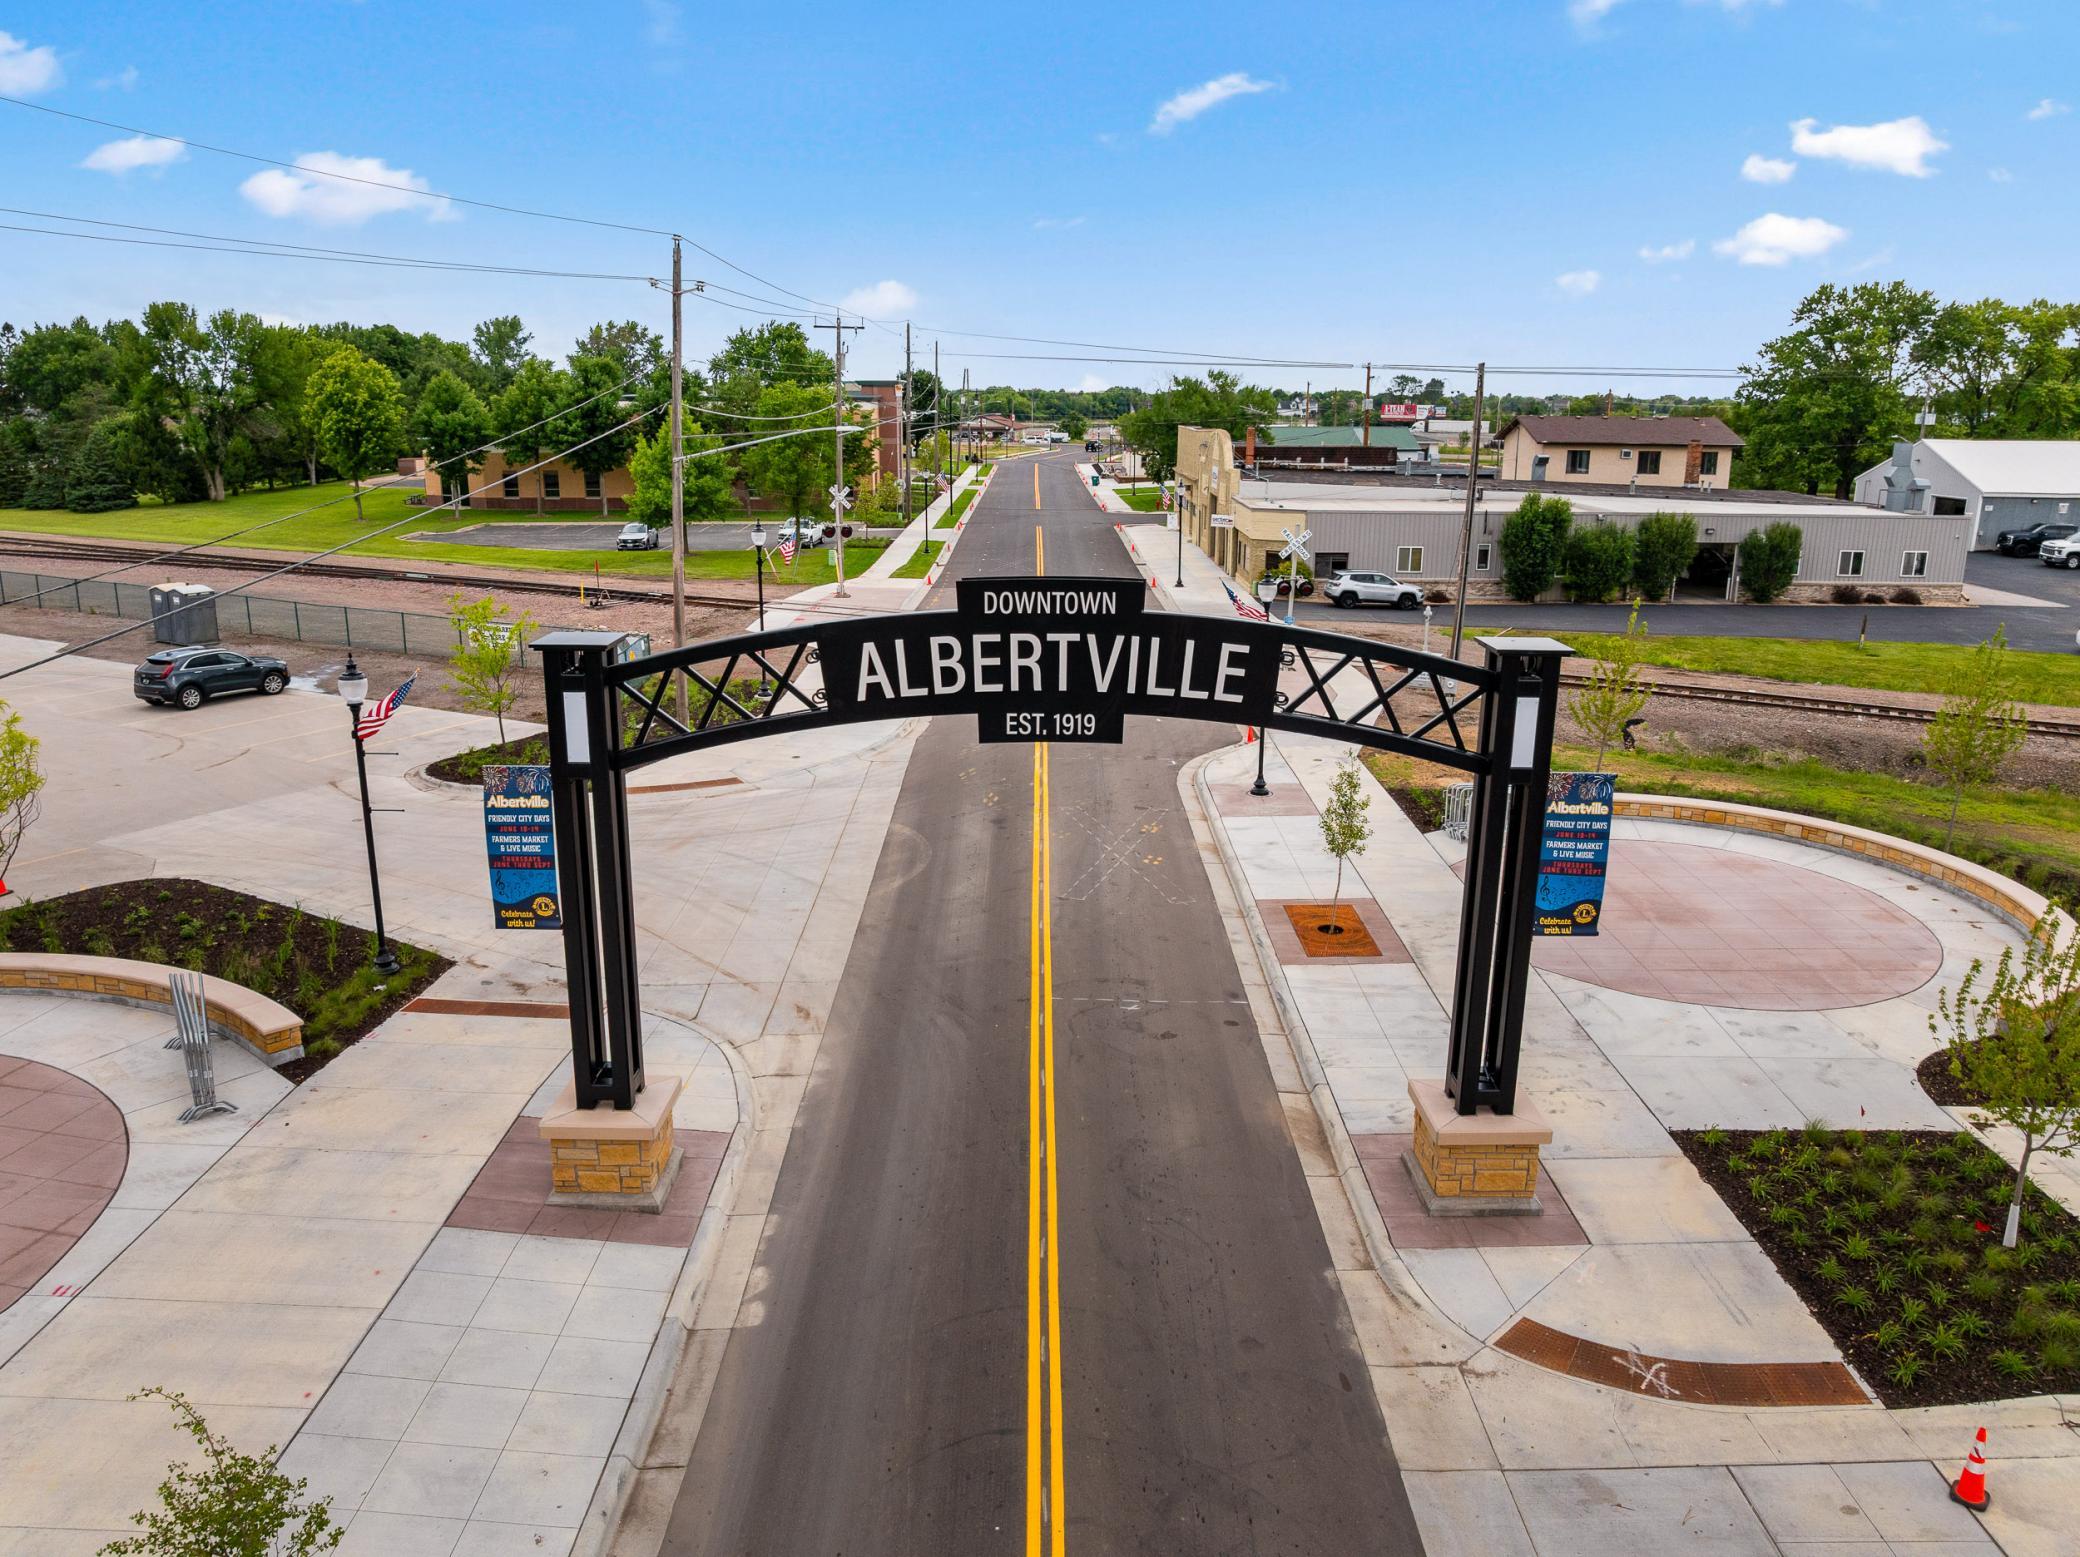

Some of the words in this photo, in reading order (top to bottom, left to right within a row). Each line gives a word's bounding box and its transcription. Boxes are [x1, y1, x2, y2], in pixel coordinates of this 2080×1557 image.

[983, 591, 1116, 615] DOWNTOWN
[857, 632, 1250, 704] ALBERTVILLE
[1006, 713, 1047, 735] EST.
[1053, 713, 1096, 735] 1919
[486, 794, 550, 808] Albertville
[1546, 800, 1609, 815] Albertville
[488, 814, 517, 822] FRIENDLY
[518, 814, 533, 822] CITY
[534, 814, 550, 822] DAYS
[1546, 820, 1575, 828] FRIENDLY
[1576, 821, 1591, 829] CITY
[1592, 821, 1608, 829] DAYS
[492, 835, 520, 843] FARMERS
[521, 835, 548, 843] MARKET
[500, 844, 505, 852] &
[506, 844, 521, 852] LIVE
[522, 844, 541, 852] MUSIC
[1546, 840, 1575, 848] FARMERS
[1576, 842, 1603, 850] MARKET
[1559, 850, 1574, 858] LIVE
[1575, 851, 1595, 859] MUSIC
[1552, 861, 1593, 869] THURSDAYS
[501, 910, 534, 918] Celebrate
[507, 919, 524, 927] with
[525, 919, 536, 927] us!
[1539, 916, 1572, 925] Celebrate
[1544, 926, 1560, 934] with
[1561, 925, 1572, 934] us!
